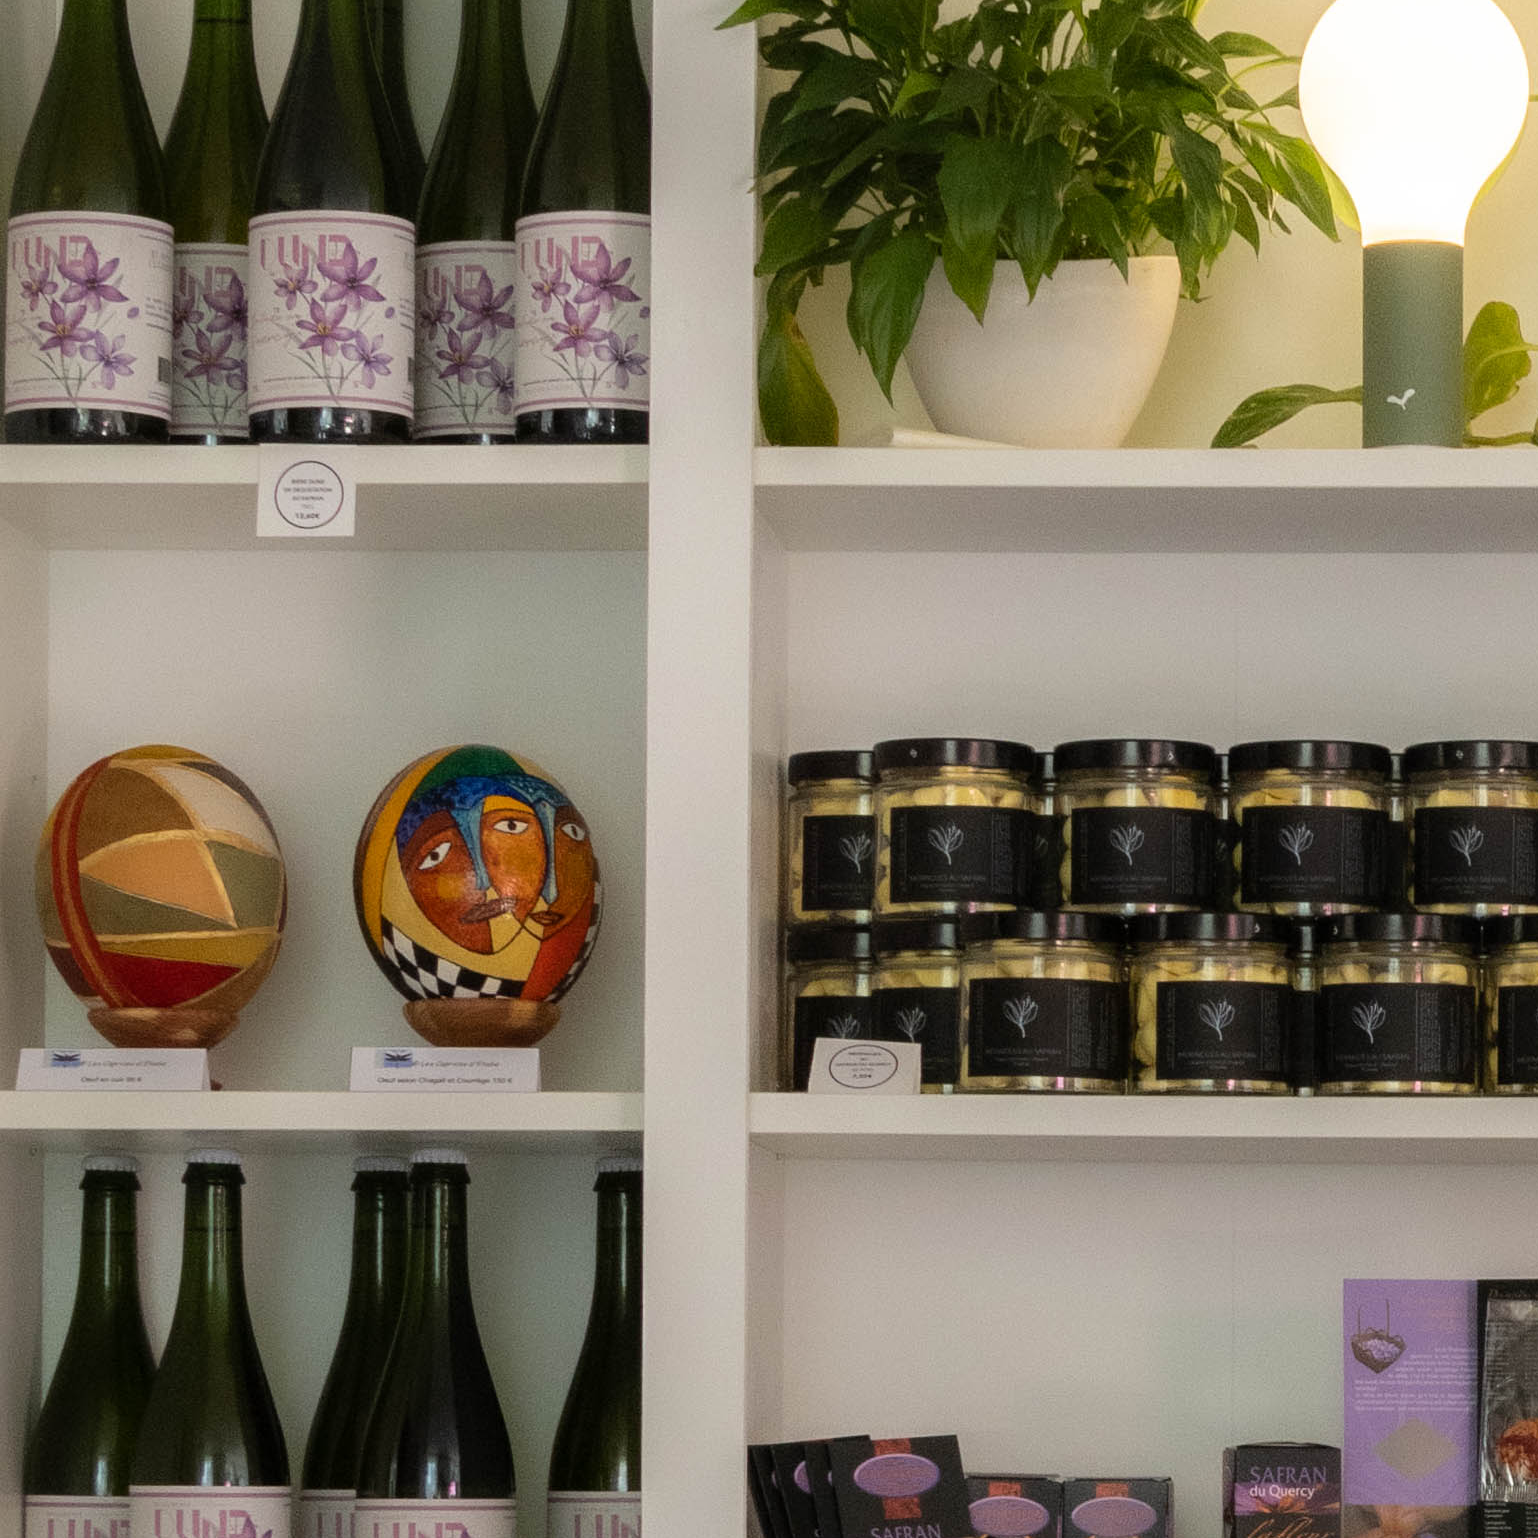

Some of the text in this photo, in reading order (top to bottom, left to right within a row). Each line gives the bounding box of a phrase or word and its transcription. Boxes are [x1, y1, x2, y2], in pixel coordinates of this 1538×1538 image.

[1249, 1466, 1327, 1484] SAFRAN
[1249, 1484, 1315, 1500] du Quercy
